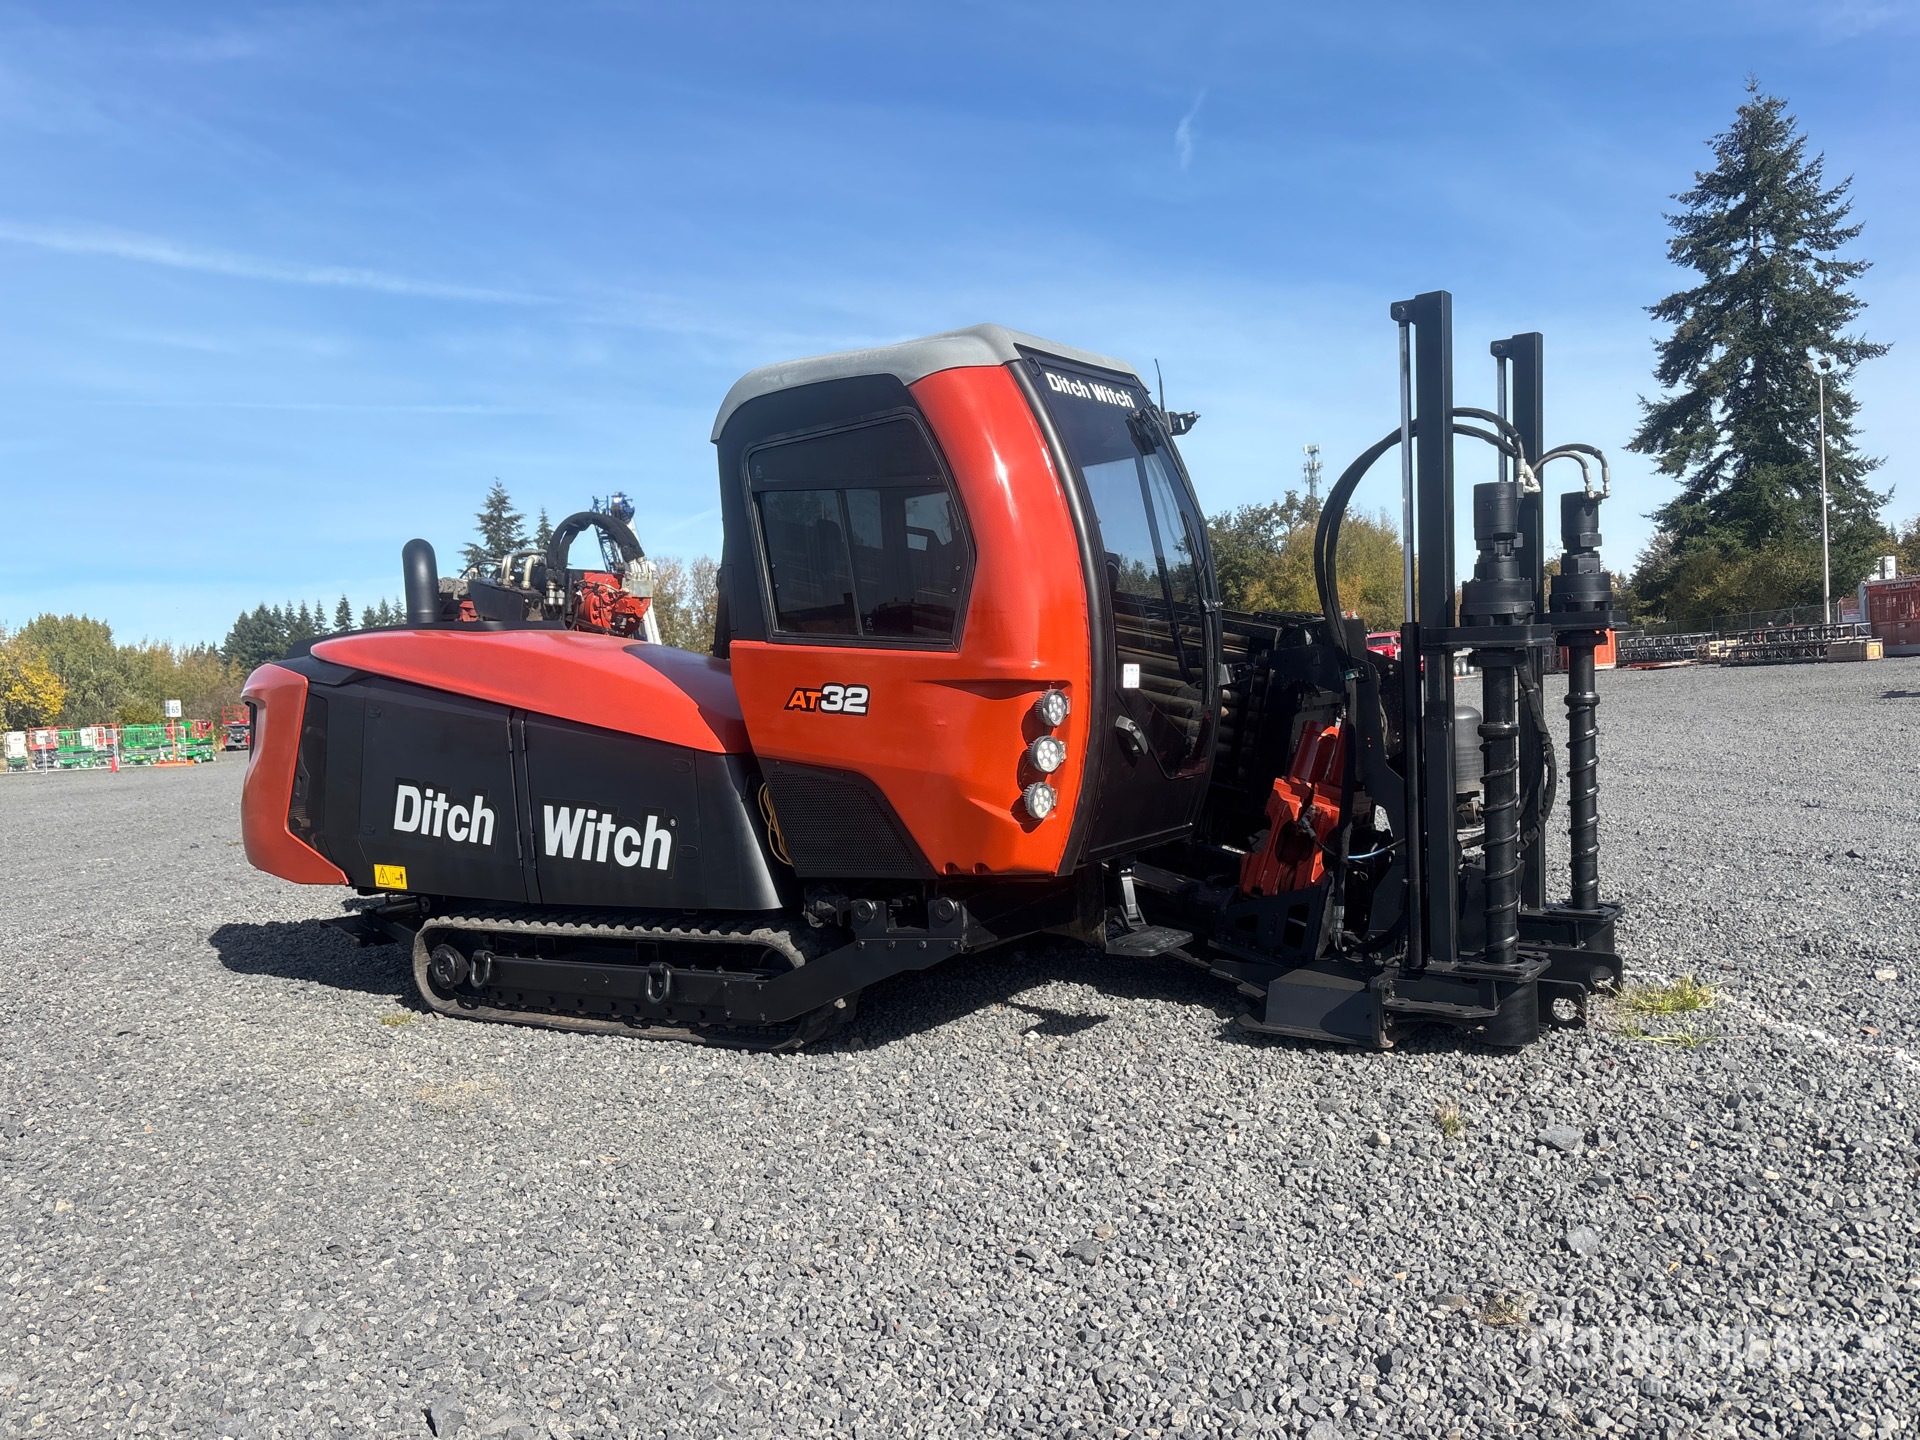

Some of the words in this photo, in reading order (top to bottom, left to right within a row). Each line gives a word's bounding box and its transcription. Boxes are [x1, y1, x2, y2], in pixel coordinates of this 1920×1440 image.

[1045, 372, 1091, 399] Ditch
[1089, 383, 1135, 408] Witch
[788, 685, 868, 713] AT32
[393, 784, 495, 846] Ditch
[543, 804, 673, 870] Witch
